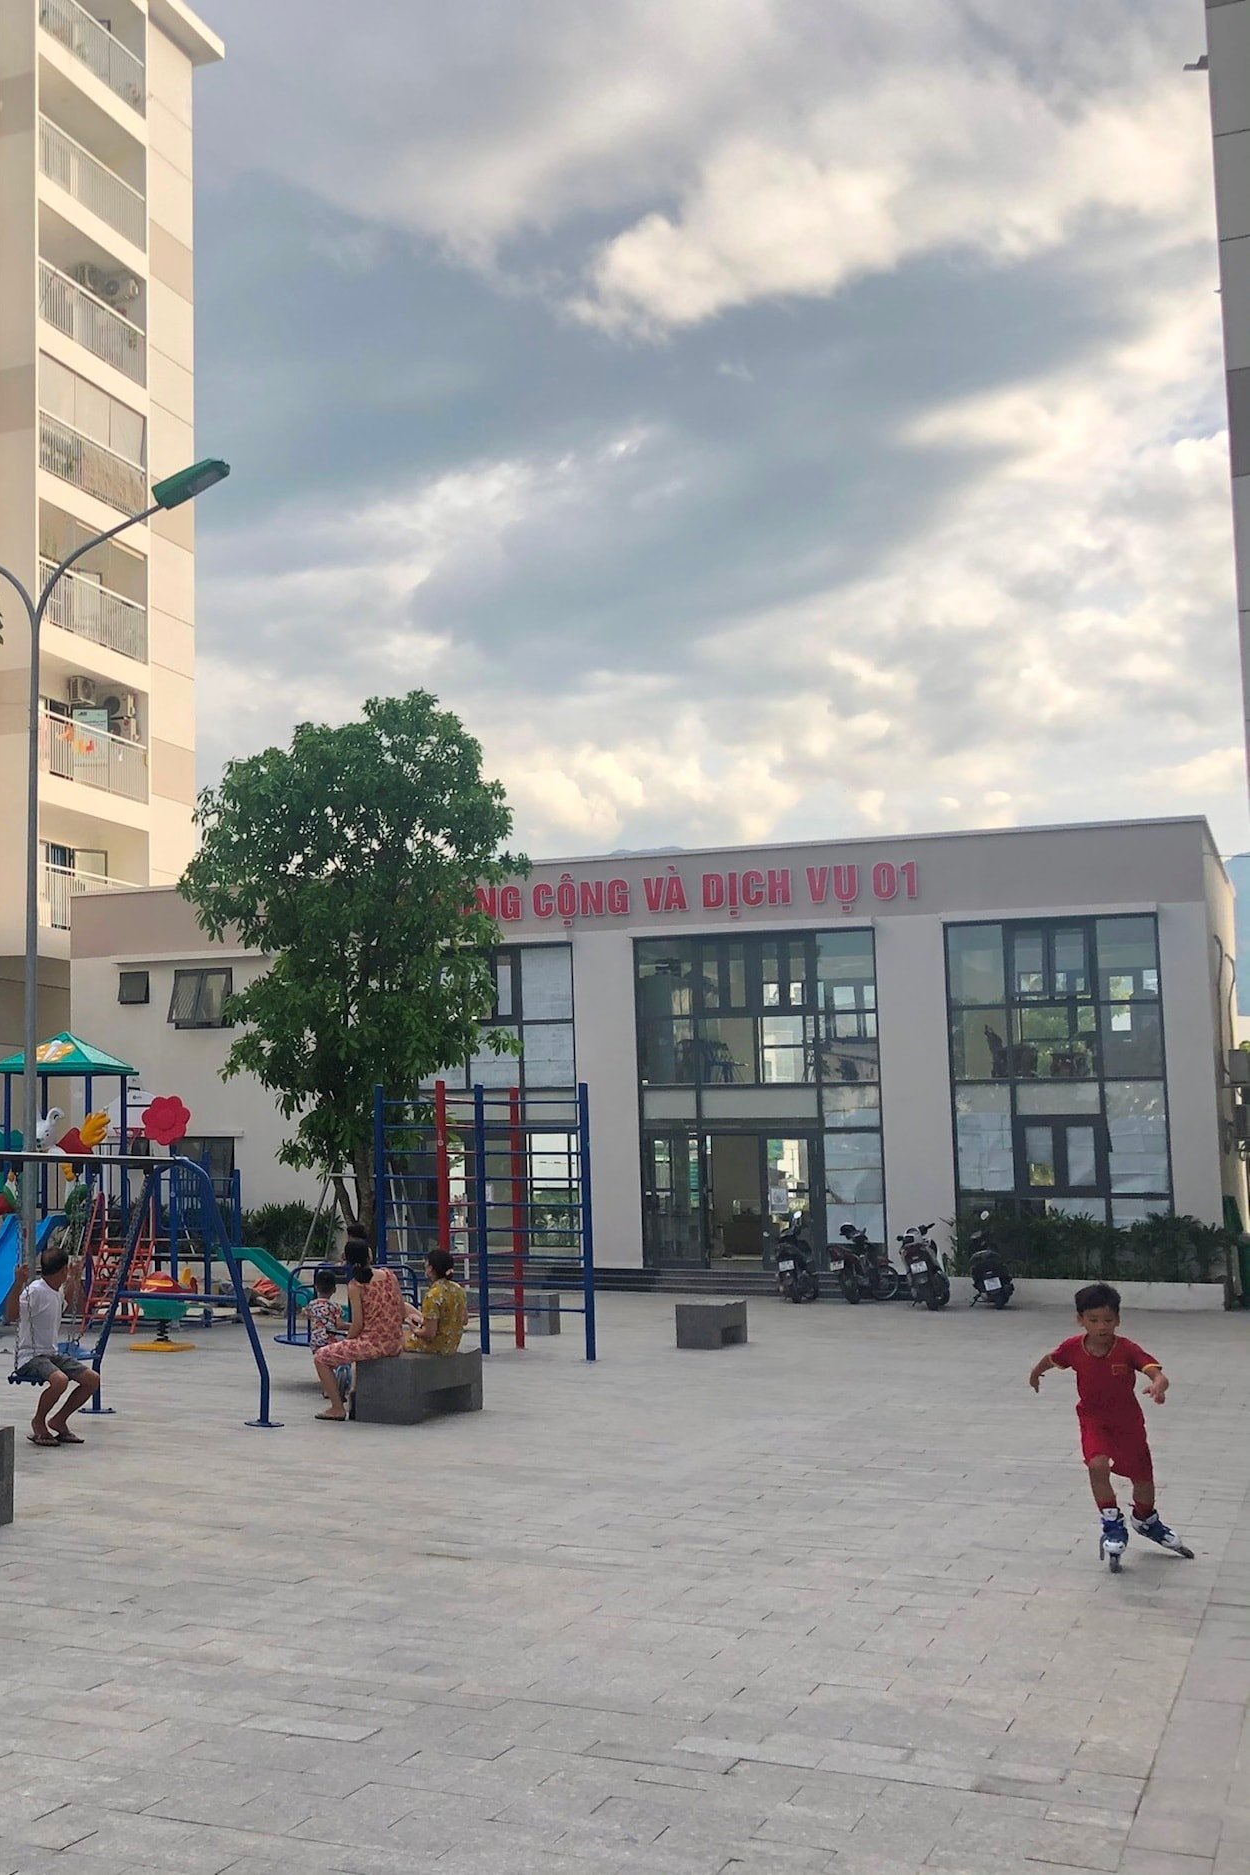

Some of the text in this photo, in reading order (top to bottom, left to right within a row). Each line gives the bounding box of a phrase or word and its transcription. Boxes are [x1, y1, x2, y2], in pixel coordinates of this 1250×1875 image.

[457, 860, 918, 927] NG CỘNG VÀ DỊCH VỤ 01
